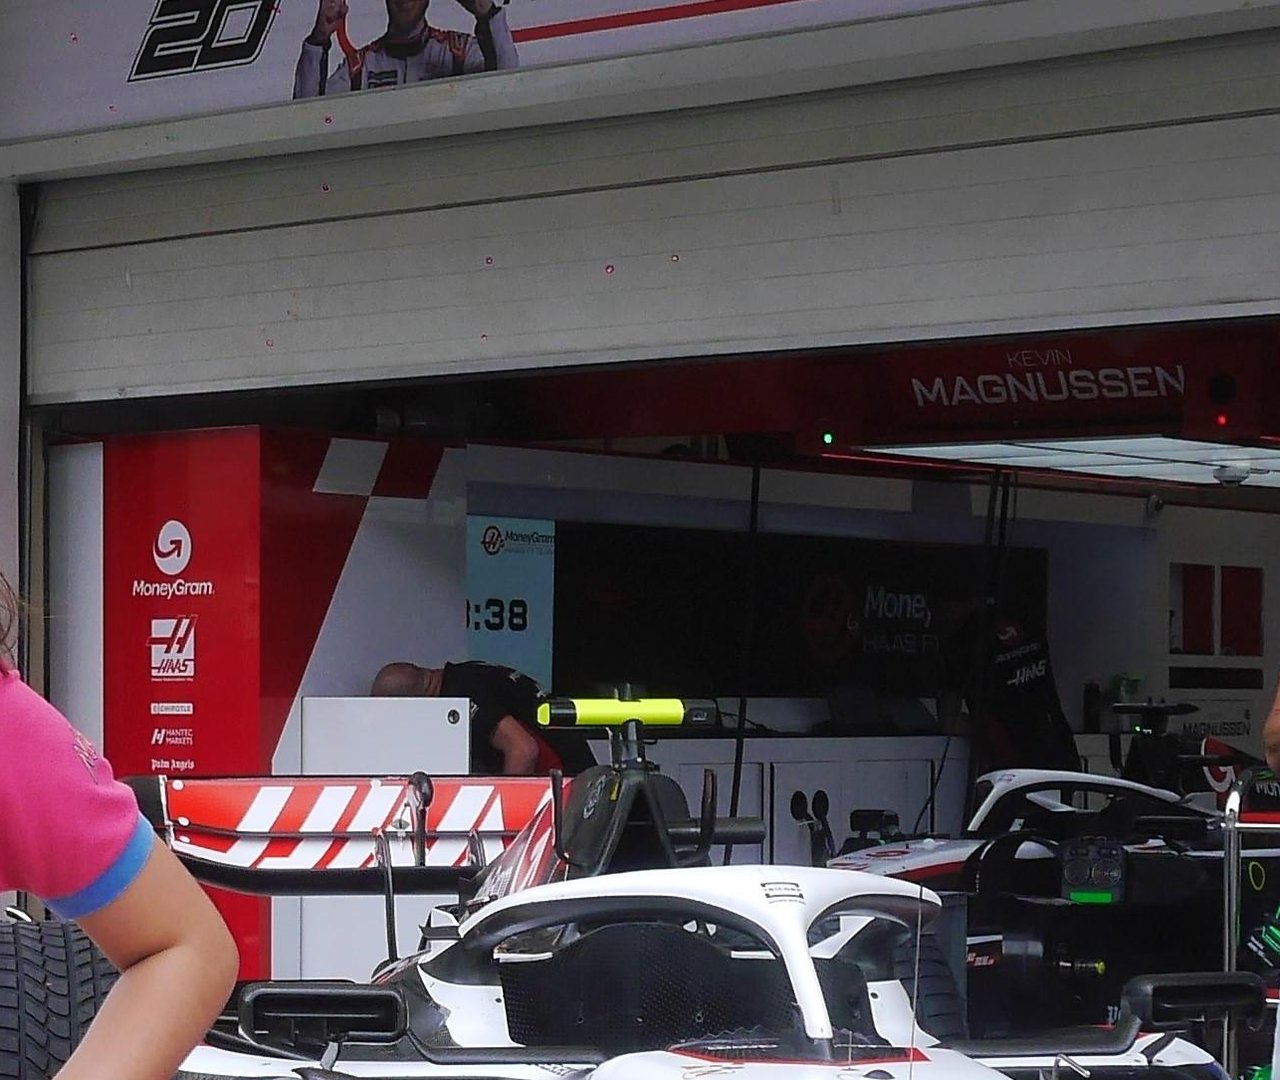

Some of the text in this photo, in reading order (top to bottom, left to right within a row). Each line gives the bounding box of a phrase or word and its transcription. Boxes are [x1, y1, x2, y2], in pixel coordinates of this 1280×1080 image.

[127, 0, 278, 82] 20
[1007, 350, 1073, 368] KEVIN
[911, 364, 1186, 407] MAGNUSSEN
[133, 579, 213, 599] MoneyGram
[152, 658, 195, 674] HAAS
[166, 728, 194, 737] HANTEC
[1182, 721, 1251, 737] MAGNUSSEN
